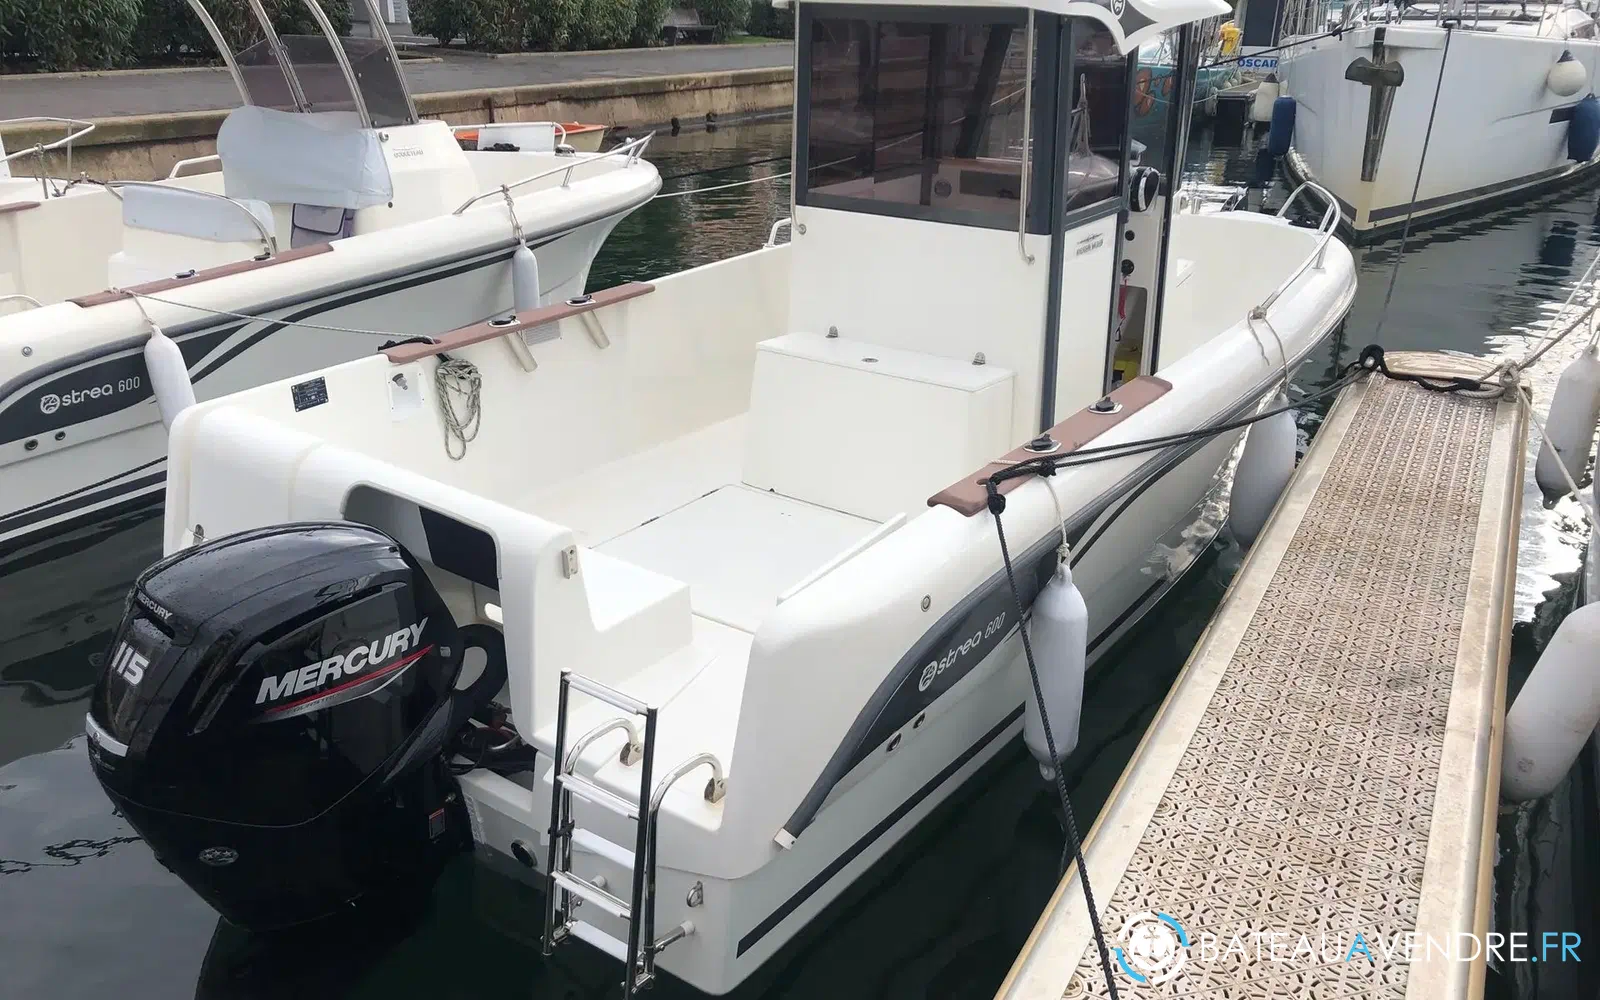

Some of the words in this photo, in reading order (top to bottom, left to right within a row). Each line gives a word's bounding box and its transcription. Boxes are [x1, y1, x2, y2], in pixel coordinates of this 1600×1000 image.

[1237, 58, 1277, 68] OSCAR
[118, 376, 140, 393] 600
[984, 611, 1006, 639] 600
[111, 640, 150, 685] 115
[255, 616, 429, 705] MERCURY
